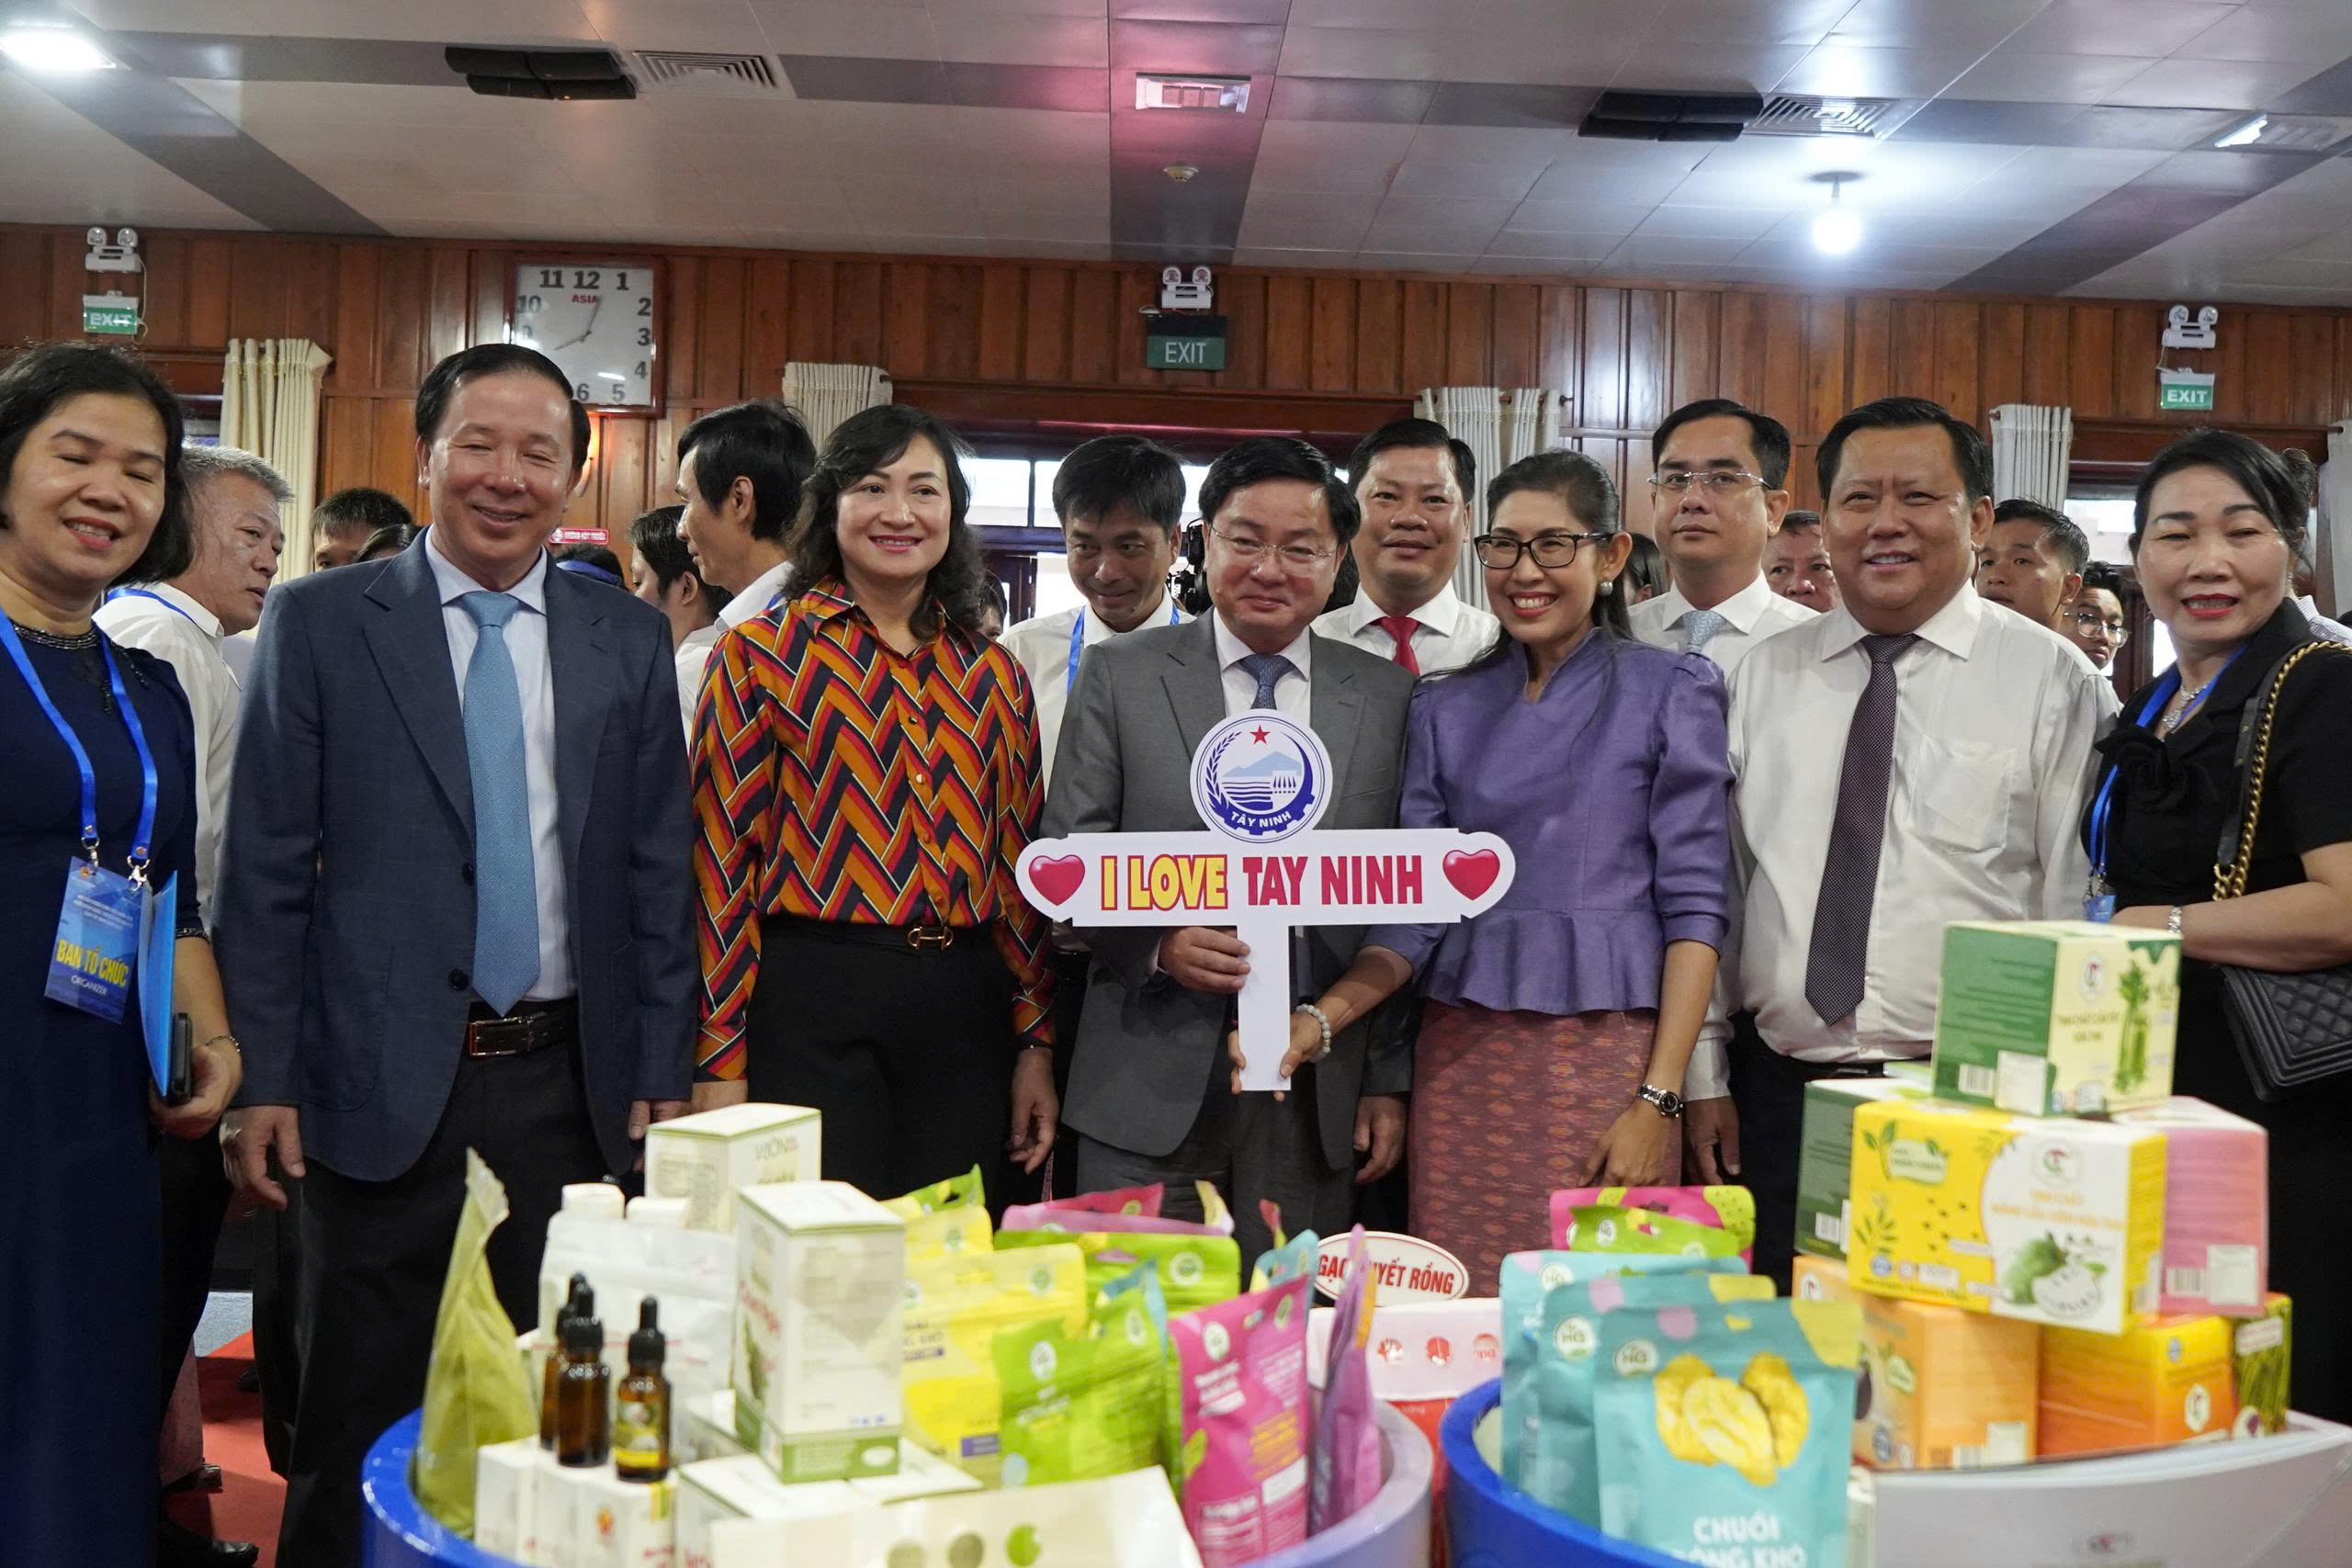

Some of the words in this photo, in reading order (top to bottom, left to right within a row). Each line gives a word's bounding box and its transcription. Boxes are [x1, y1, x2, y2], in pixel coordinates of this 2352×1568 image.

[539, 269, 564, 288] 11
[573, 270, 601, 290] 12
[616, 272, 630, 291] 1
[516, 295, 542, 314] 10
[571, 294, 599, 304] ASIA
[637, 297, 651, 317] 2
[89, 311, 133, 327] EXIT
[637, 327, 651, 346] 3
[1164, 341, 1207, 365] EXIT
[634, 360, 648, 379] 4
[576, 382, 590, 401] 6
[612, 383, 626, 402] 5
[2166, 389, 2208, 403] EXIT
[1230, 810, 1257, 828] TÂY
[1259, 810, 1293, 829] NINH
[1101, 854, 1118, 911] I
[1126, 853, 1228, 912] LOVE
[1242, 855, 1309, 907] TAY
[1320, 855, 1423, 907] NINH
[56, 940, 83, 970] BAN
